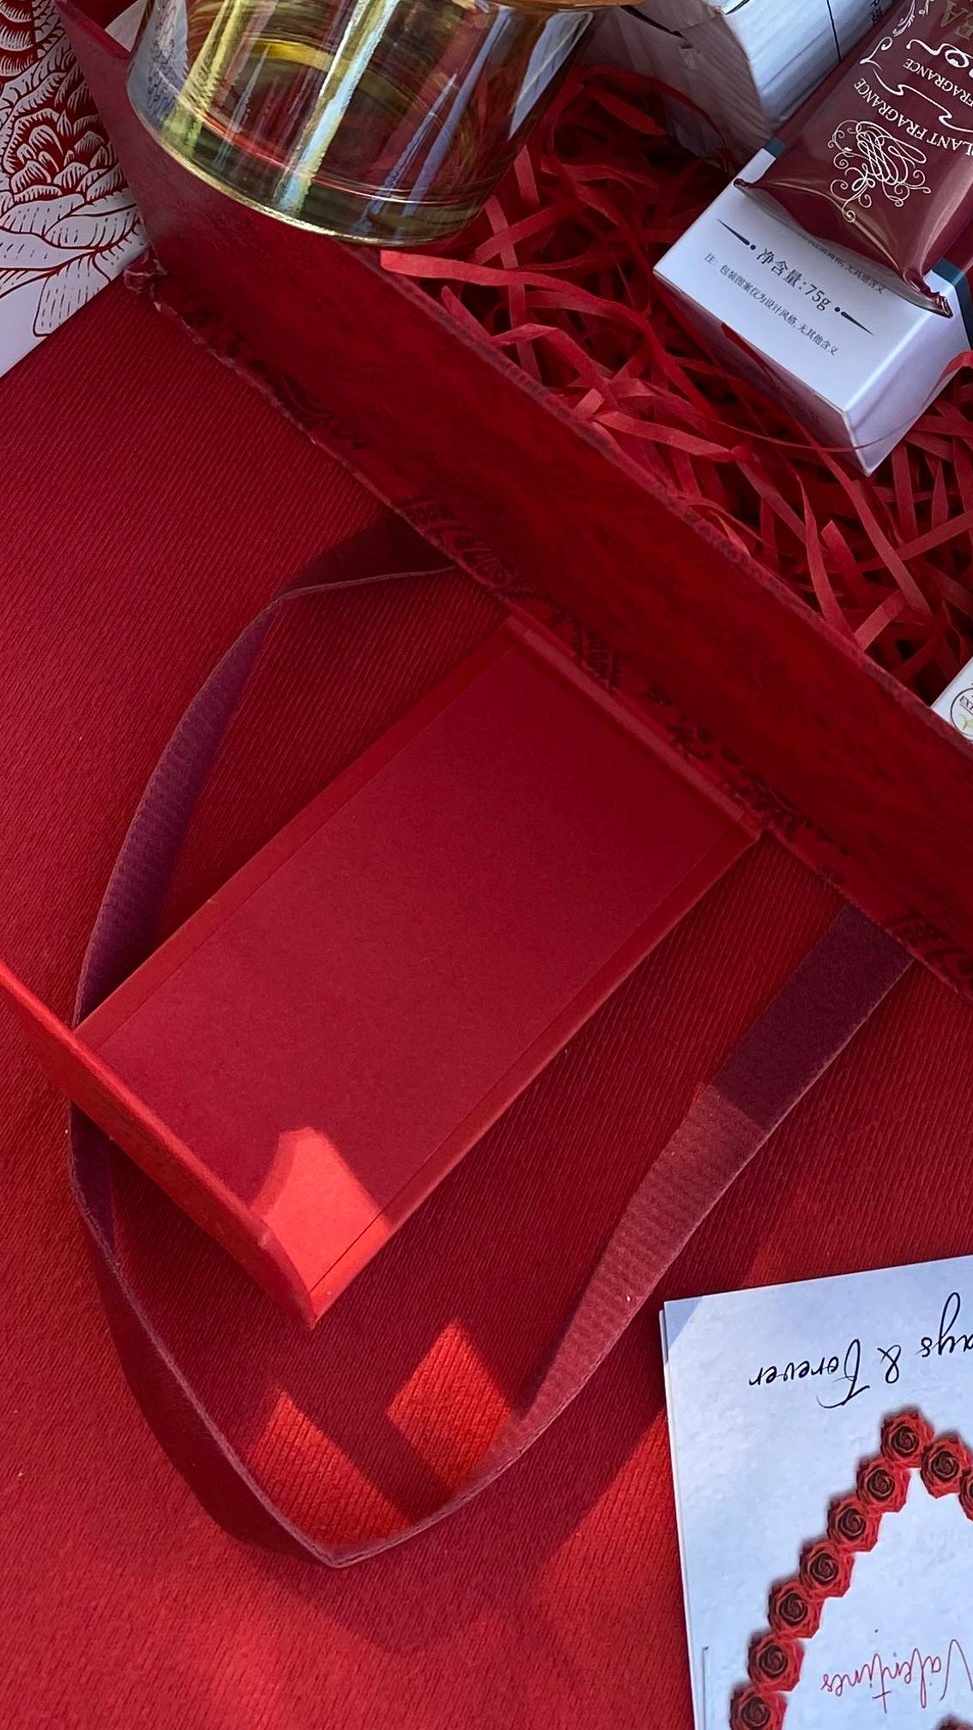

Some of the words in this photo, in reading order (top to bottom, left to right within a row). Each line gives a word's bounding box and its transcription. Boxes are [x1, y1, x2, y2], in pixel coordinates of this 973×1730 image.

[853, 78, 929, 141] FRAGRANCE
[748, 1338, 870, 1410] Forever
[877, 1343, 903, 1385] &
[820, 1637, 973, 1715] Valentines
